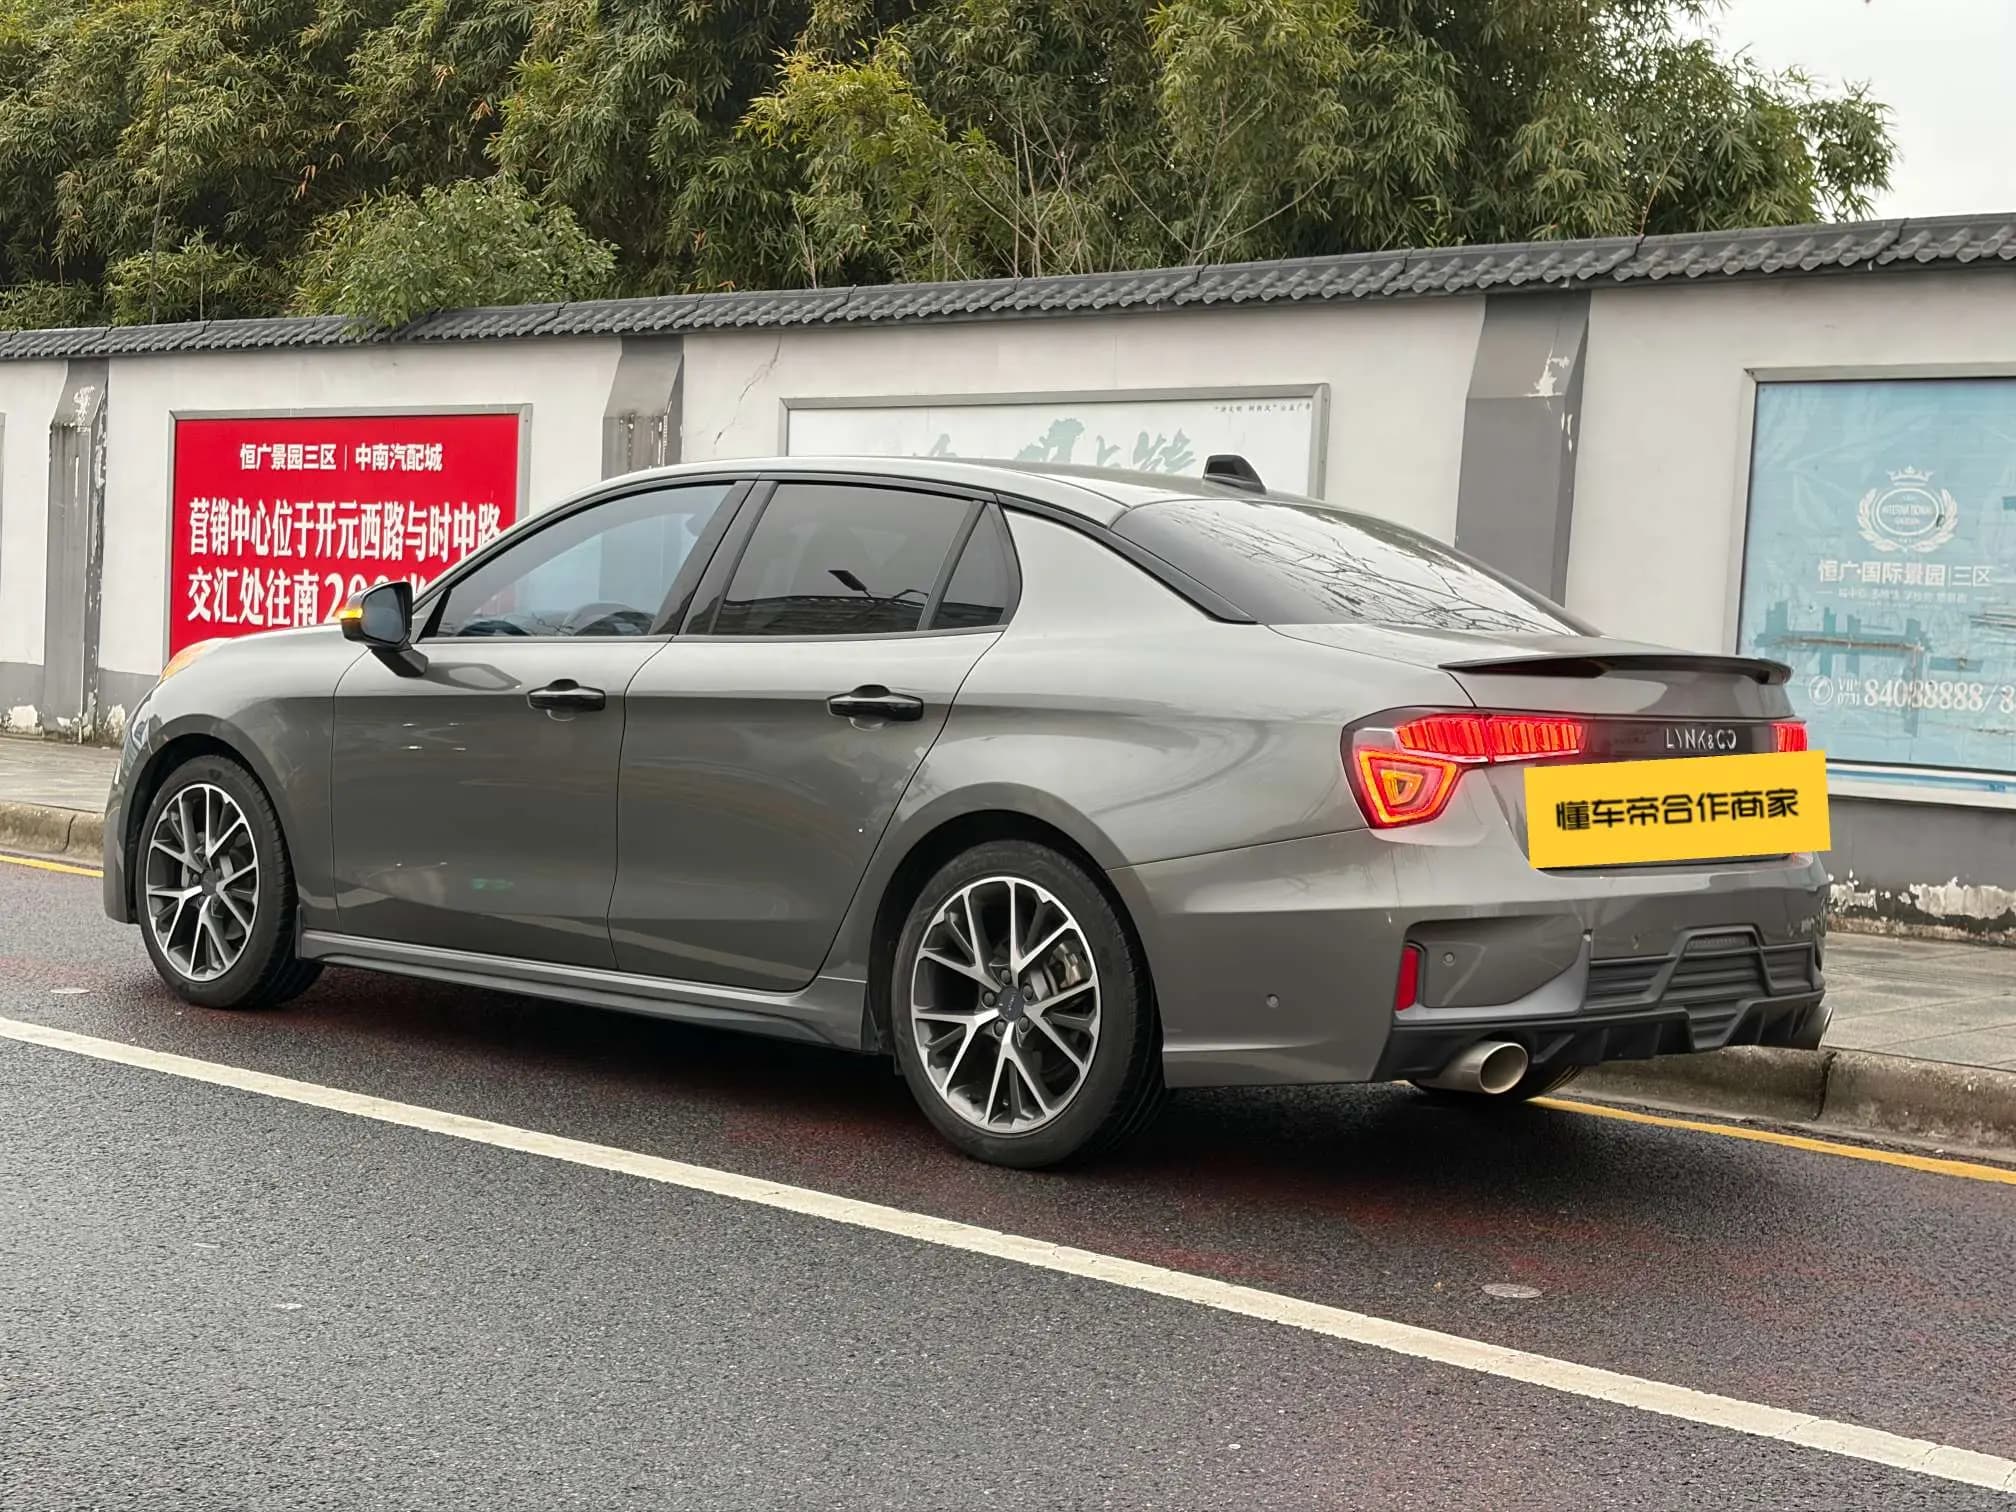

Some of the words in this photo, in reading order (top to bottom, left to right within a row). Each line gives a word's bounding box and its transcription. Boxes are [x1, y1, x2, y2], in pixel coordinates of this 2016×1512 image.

[240, 443, 336, 471] 恒广景园三区
[355, 442, 443, 472] 中南汽配城
[189, 497, 501, 563] 营销中心位于开元西路与时中路
[186, 566, 428, 628] 交汇处往南2
